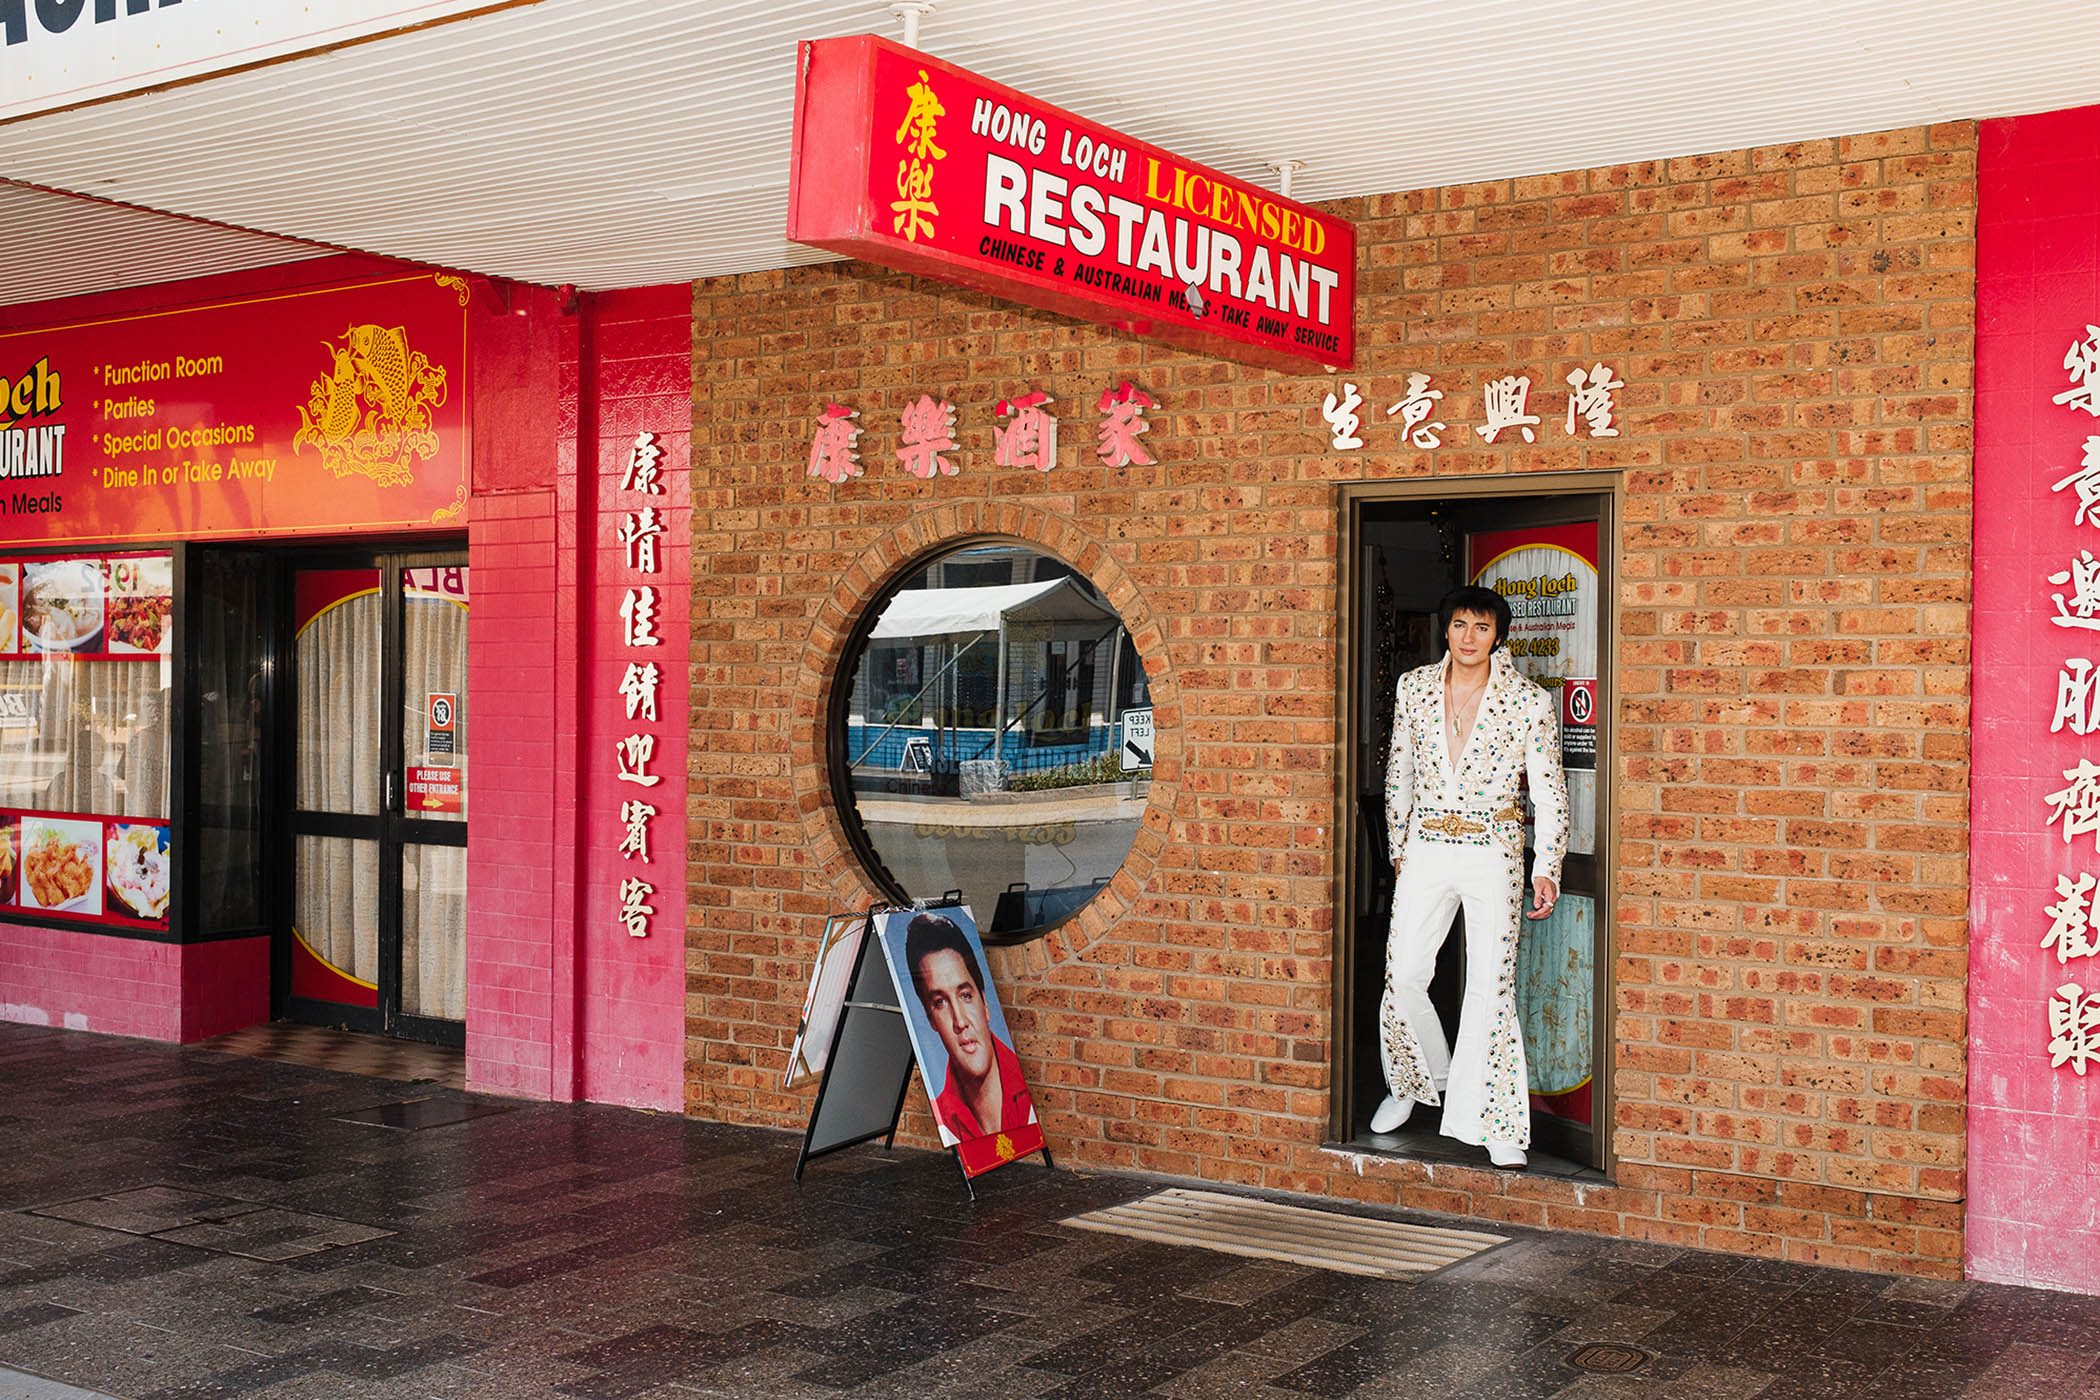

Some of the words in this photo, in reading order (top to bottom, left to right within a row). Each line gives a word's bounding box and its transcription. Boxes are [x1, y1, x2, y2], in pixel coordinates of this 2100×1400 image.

[890, 69, 948, 243] 康樂
[971, 97, 1047, 156] HONG
[1060, 128, 1128, 184] LOCH
[1145, 157, 1326, 255] LICENSED
[983, 151, 1340, 326] RESTAURANT
[979, 235, 1046, 272] CHINESE
[1053, 257, 1065, 277] &
[1073, 262, 1162, 302] AUSTRALIAN
[1168, 290, 1211, 317] MES
[1221, 304, 1251, 329] TAKE
[1256, 316, 1289, 339] AWAY
[1294, 326, 1340, 353] SERVICE
[104, 360, 170, 386] Function
[176, 355, 223, 378] Room
[104, 396, 155, 420] Parties
[103, 428, 162, 458] Special
[166, 422, 255, 449] Occasions
[103, 466, 138, 489] Dine
[143, 464, 157, 486] In
[162, 468, 179, 485] or
[182, 462, 222, 483] Take
[228, 457, 276, 483] Away
[12, 491, 63, 515] Meals
[1492, 576, 1537, 600] Hong
[1539, 572, 1578, 597] Loch
[1527, 598, 1577, 618] RESTAURANT
[1524, 622, 1555, 632] Australian
[1556, 621, 1576, 631] Meals
[1529, 637, 1560, 657] 4233
